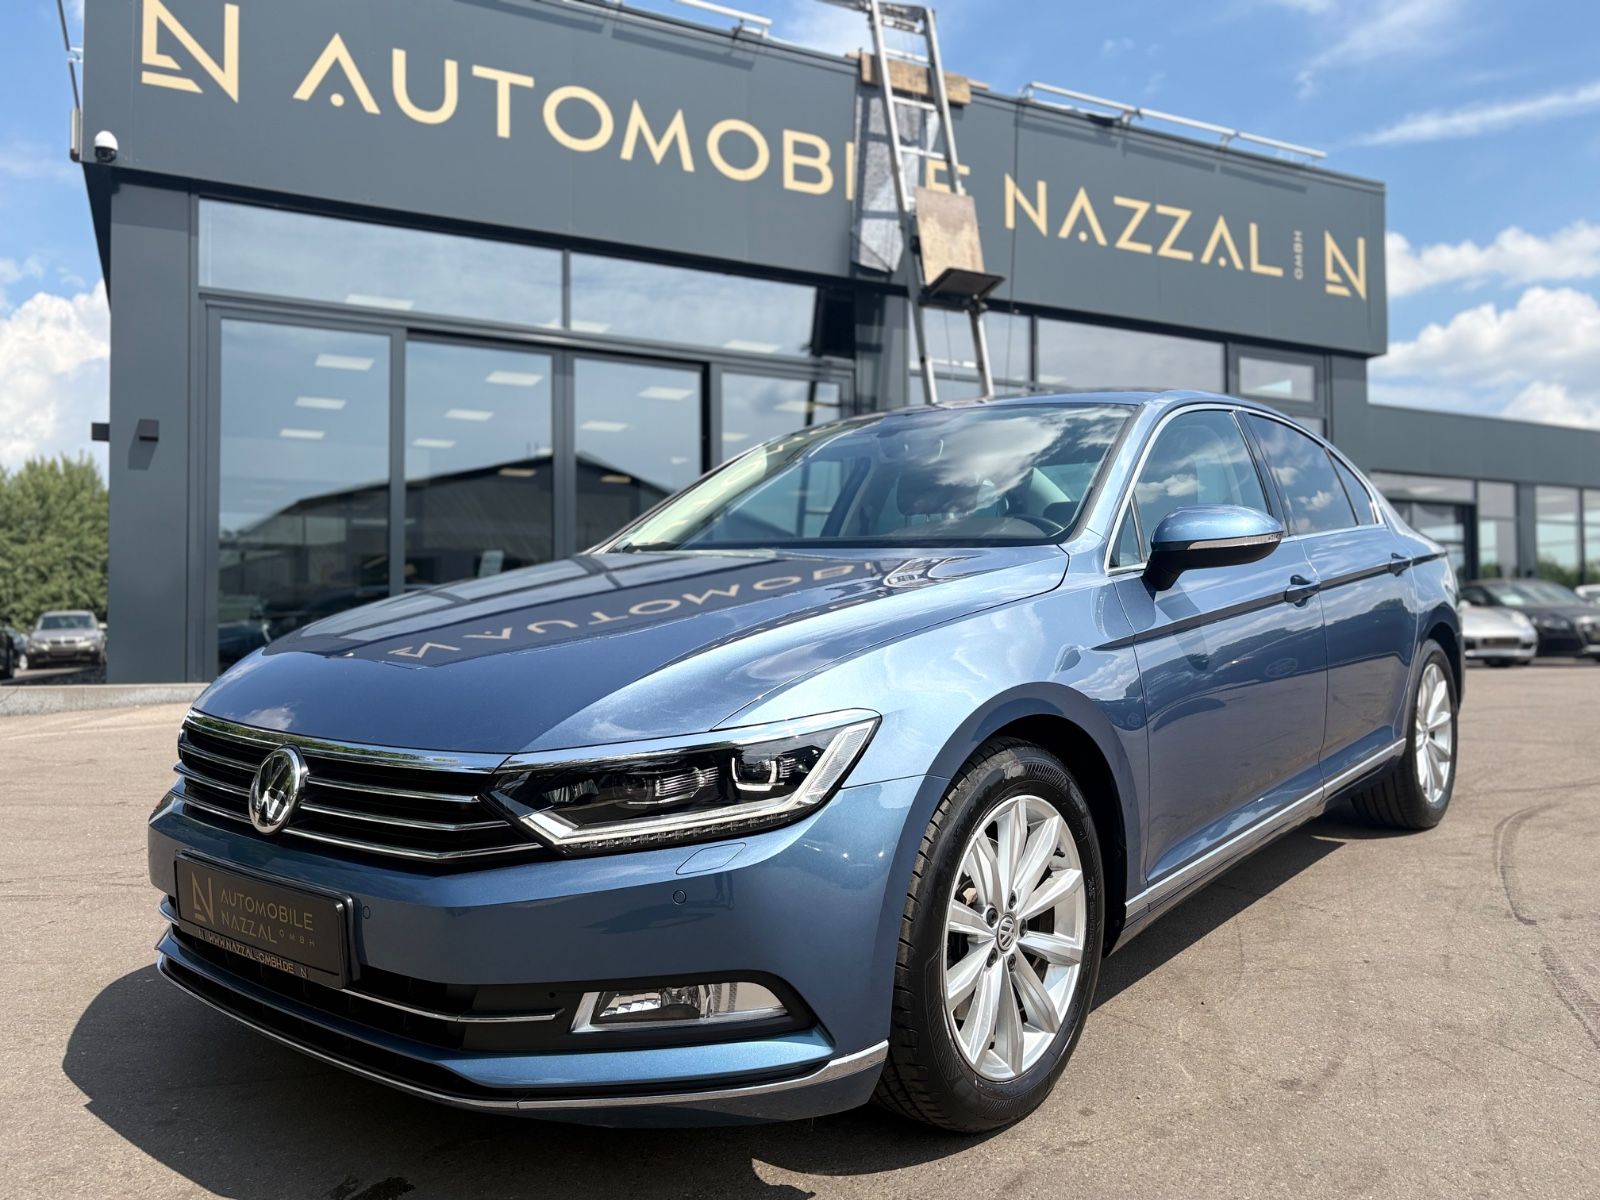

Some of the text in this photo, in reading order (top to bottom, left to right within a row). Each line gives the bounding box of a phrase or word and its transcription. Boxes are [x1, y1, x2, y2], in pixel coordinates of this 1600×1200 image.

[293, 33, 971, 200] AUTOMOBIE
[1004, 174, 1284, 277] NAZZAL
[220, 888, 314, 931] AUTOMOBILE
[221, 911, 278, 944] NAZZAL
